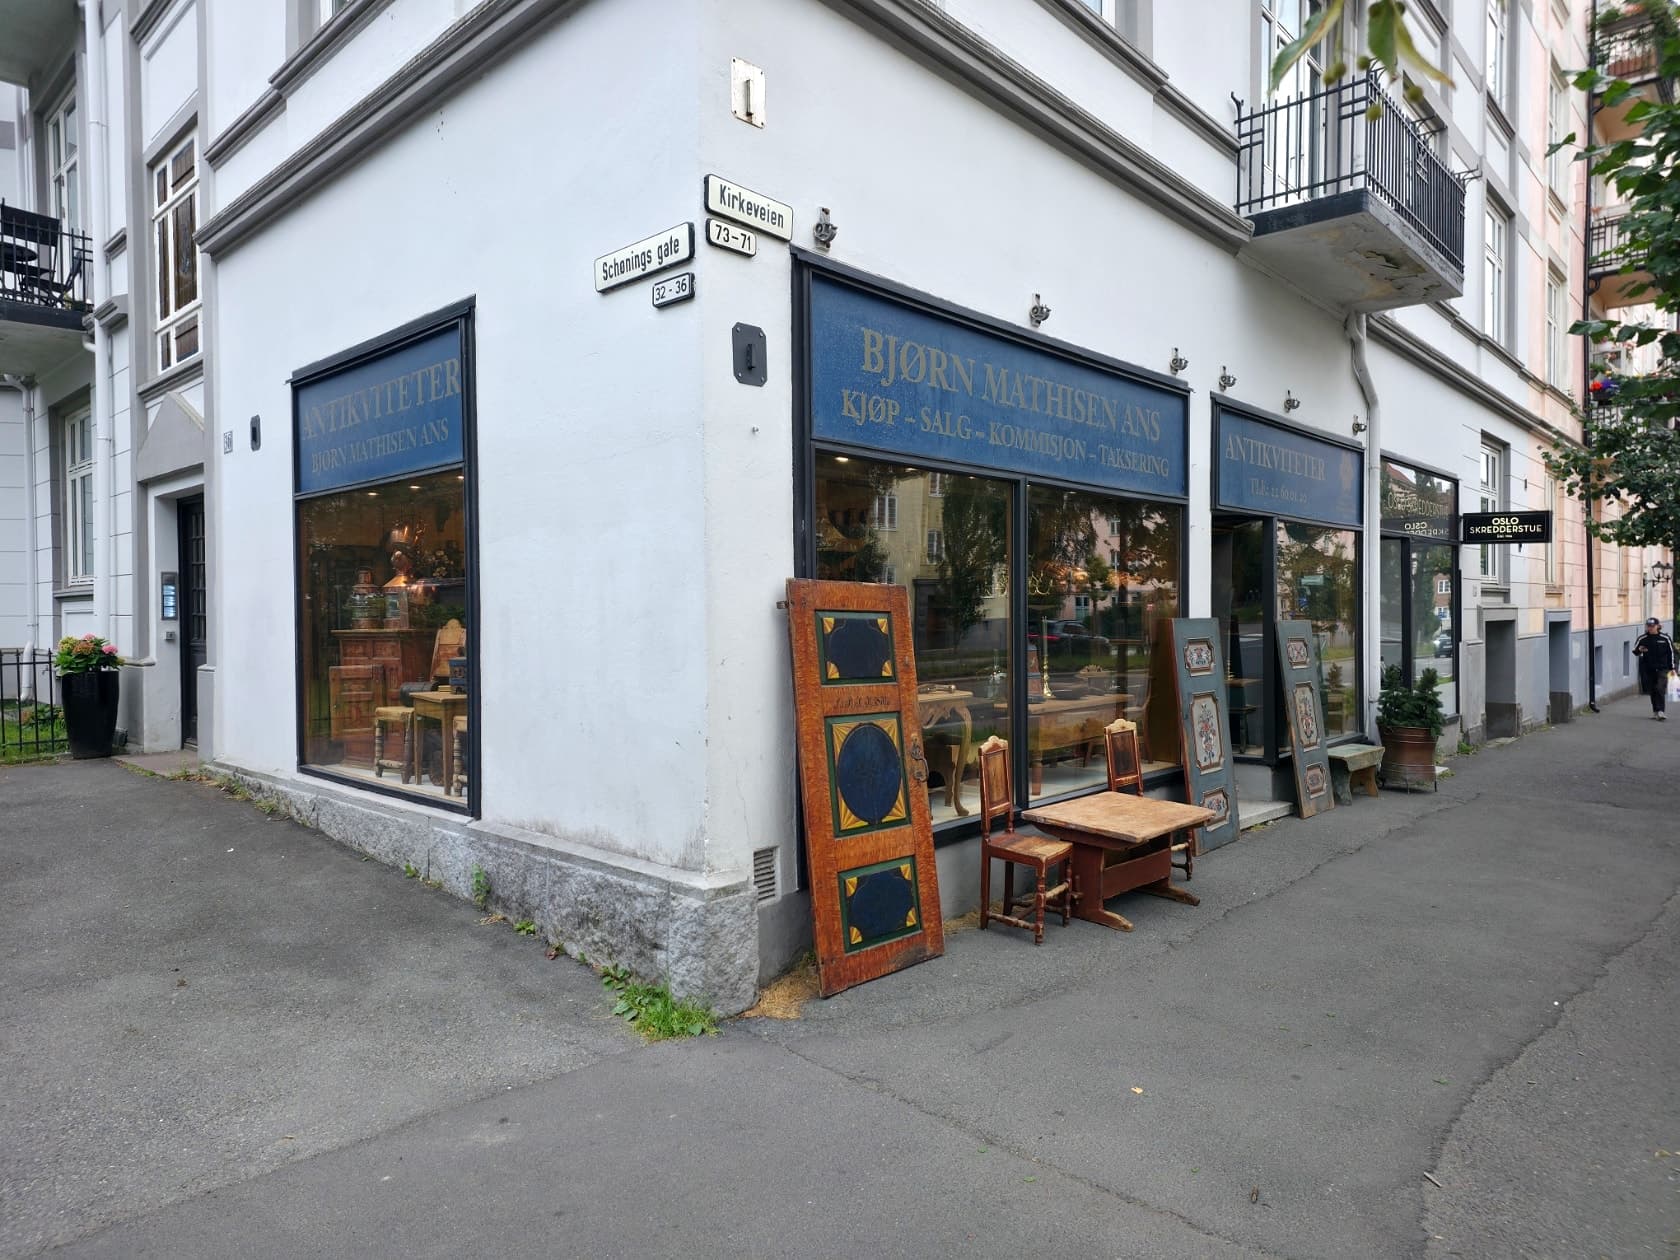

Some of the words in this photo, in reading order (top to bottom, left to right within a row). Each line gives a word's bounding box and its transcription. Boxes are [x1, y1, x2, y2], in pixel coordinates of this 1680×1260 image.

[719, 183, 784, 229] Kirkeveien
[657, 235, 680, 266] gate
[302, 358, 462, 440] ANTIKVITETER
[862, 328, 976, 396] BJØRN
[982, 363, 1118, 429] MATHISEN
[1121, 404, 1162, 441] ANS
[349, 429, 417, 463] MATHISEN
[420, 416, 449, 446] ANS
[841, 388, 901, 426] KJØP
[920, 407, 972, 439] SALG
[989, 422, 1087, 461] KOMMISJON
[1099, 443, 1170, 477] TAKSERING
[1225, 433, 1326, 480] ANTIKVITETER
[1469, 525, 1542, 534] SKREDDERSTUE
[1492, 517, 1519, 525] OSLO
